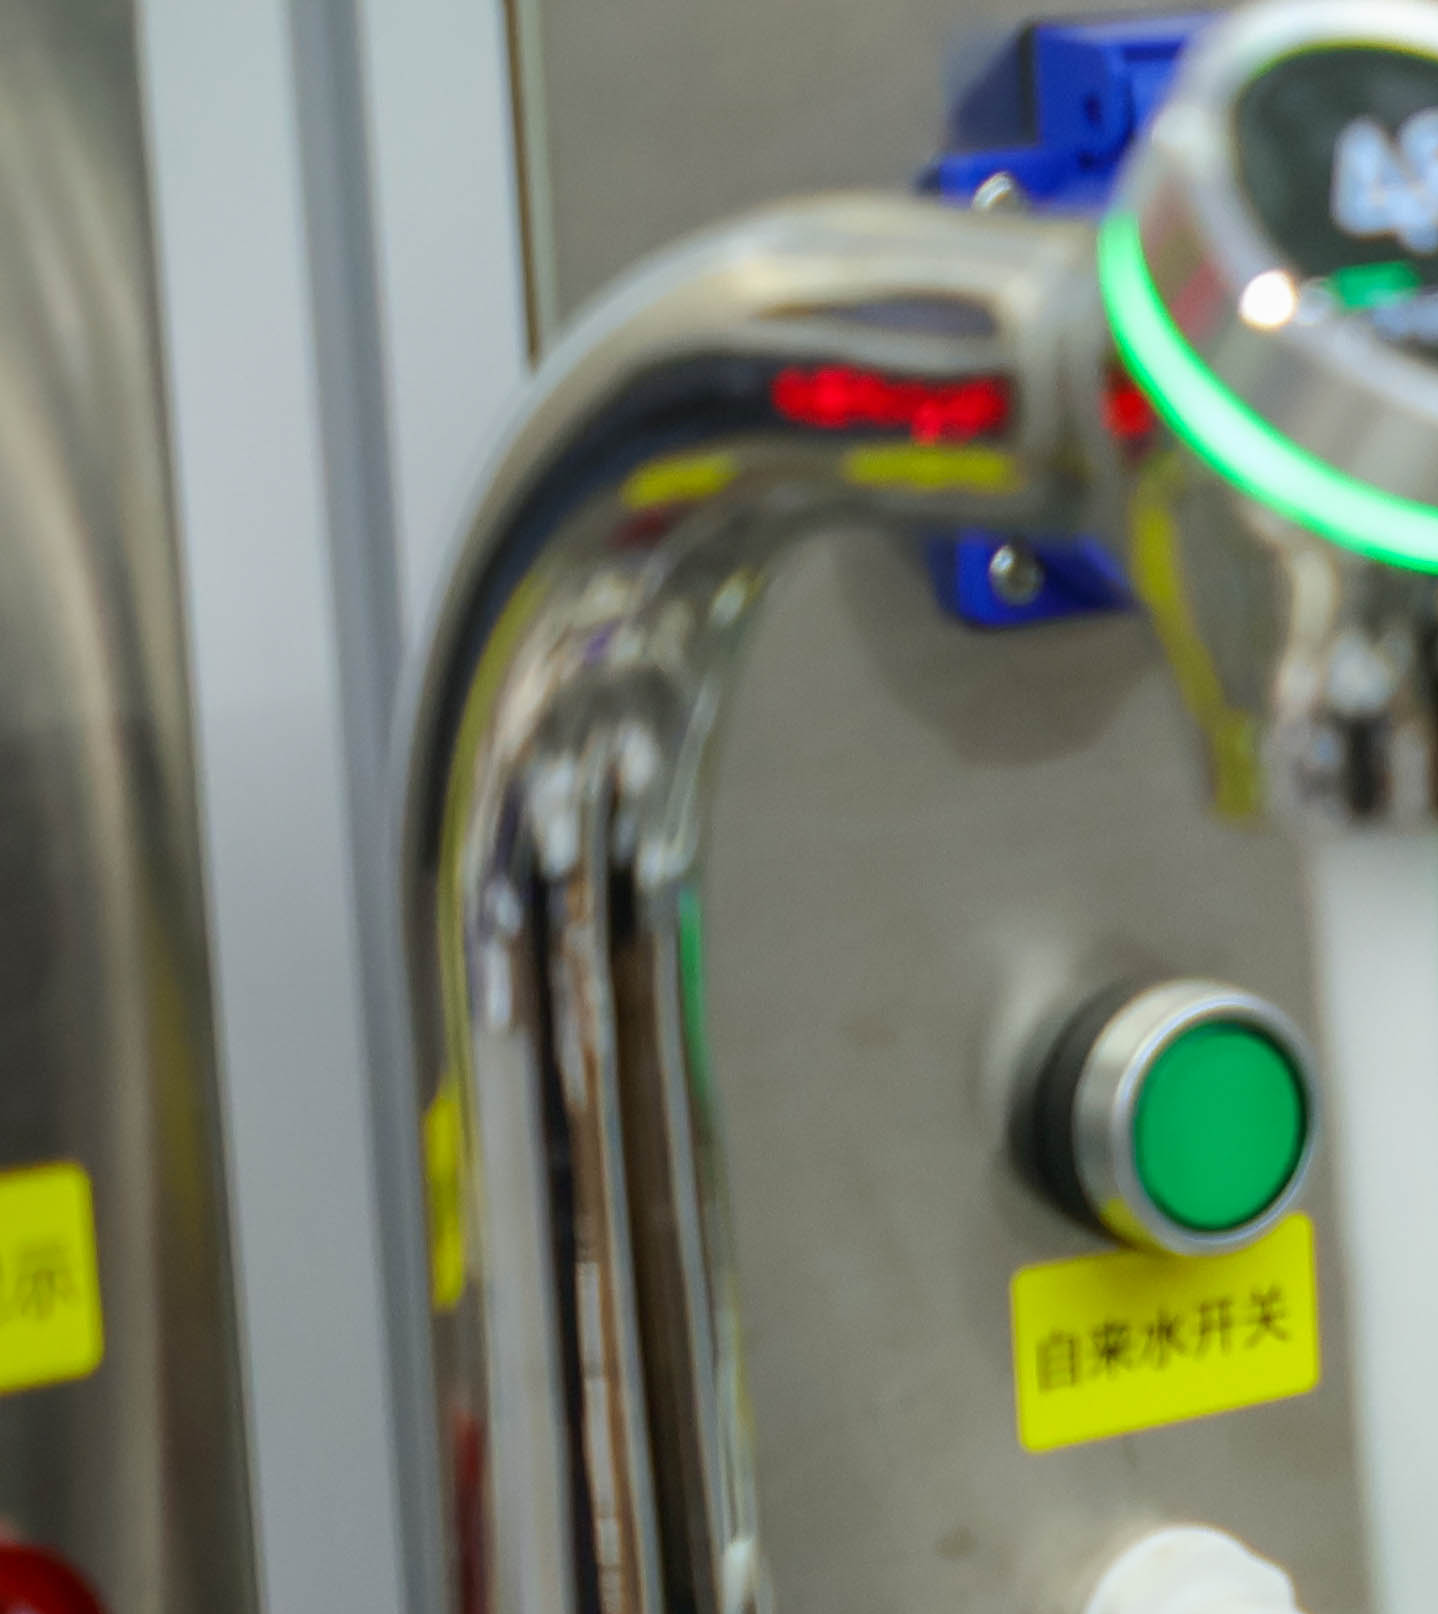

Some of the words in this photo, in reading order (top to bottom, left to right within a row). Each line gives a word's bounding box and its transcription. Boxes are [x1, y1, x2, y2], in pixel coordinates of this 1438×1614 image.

[1036, 1282, 1291, 1394] 自来水开关
